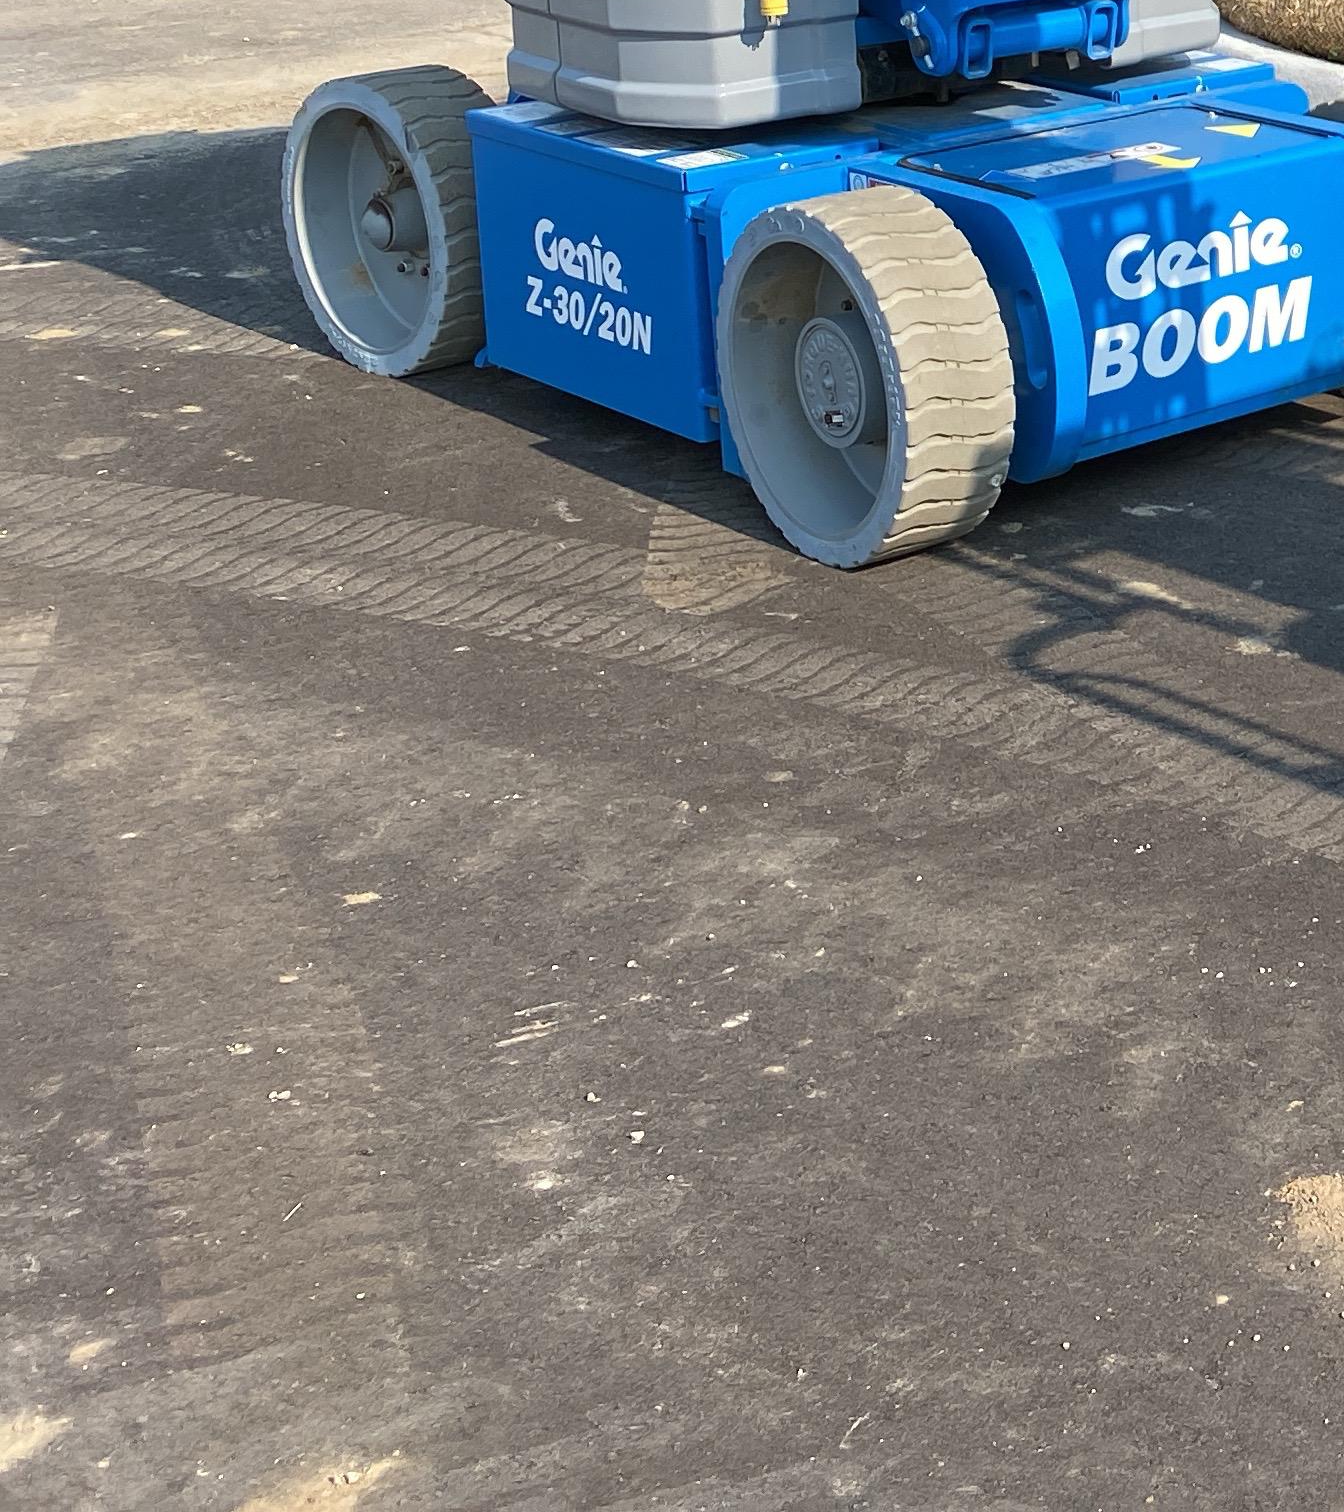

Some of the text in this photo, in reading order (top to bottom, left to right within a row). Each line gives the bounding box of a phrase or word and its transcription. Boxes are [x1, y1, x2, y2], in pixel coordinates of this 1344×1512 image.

[534, 218, 625, 292] Genie
[526, 275, 652, 355] Z-30/20N
[1088, 275, 1313, 397] BOOM
